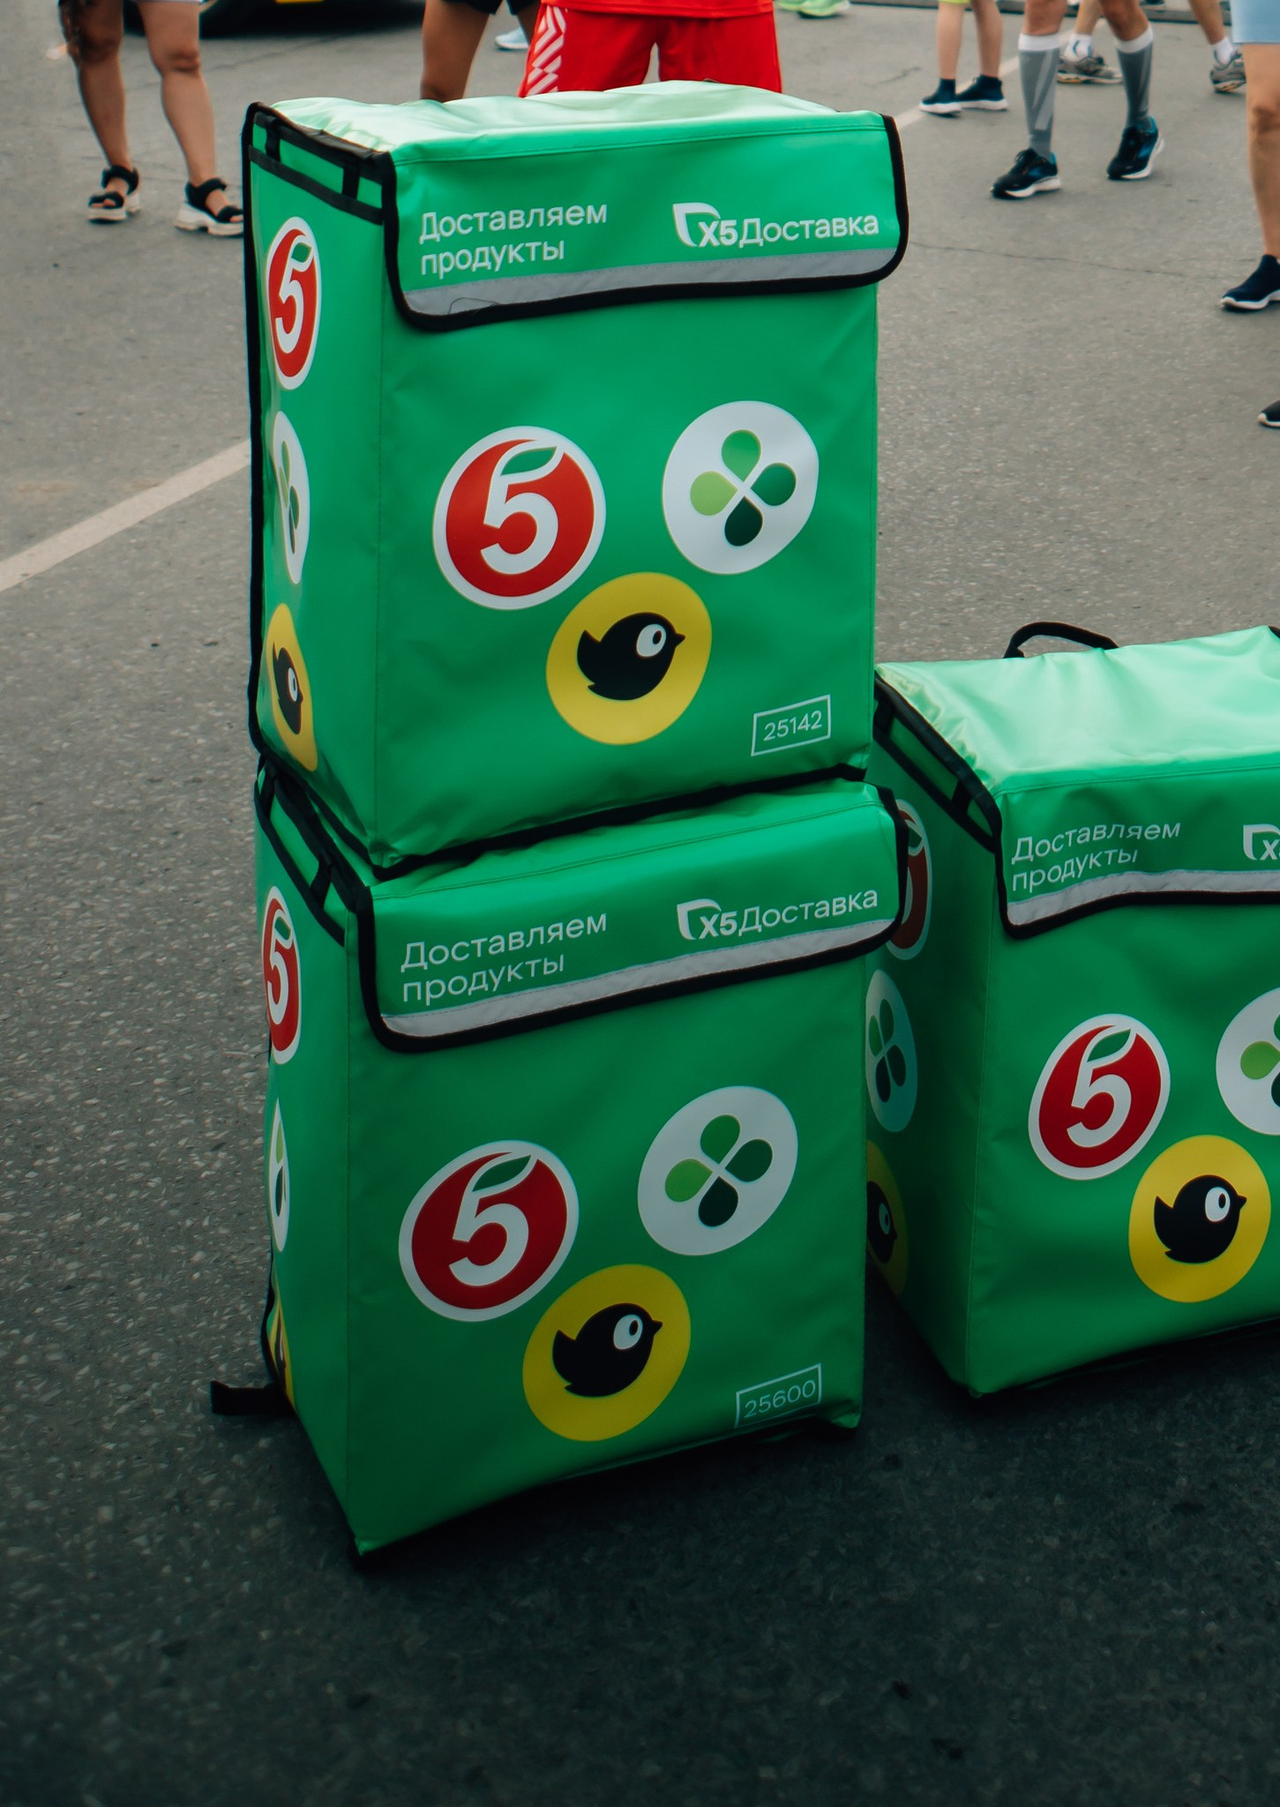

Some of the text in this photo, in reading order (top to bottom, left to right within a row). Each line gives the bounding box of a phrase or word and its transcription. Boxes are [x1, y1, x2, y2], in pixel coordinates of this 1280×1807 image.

[419, 205, 606, 244] Доставляем
[421, 241, 564, 280] продукты
[763, 711, 822, 741] 25142
[1012, 822, 1180, 865] Доставляем
[1013, 850, 1138, 892] продукты
[401, 914, 607, 973] Доставляем
[402, 954, 565, 1006] продукты
[744, 1378, 817, 1418] 25600
